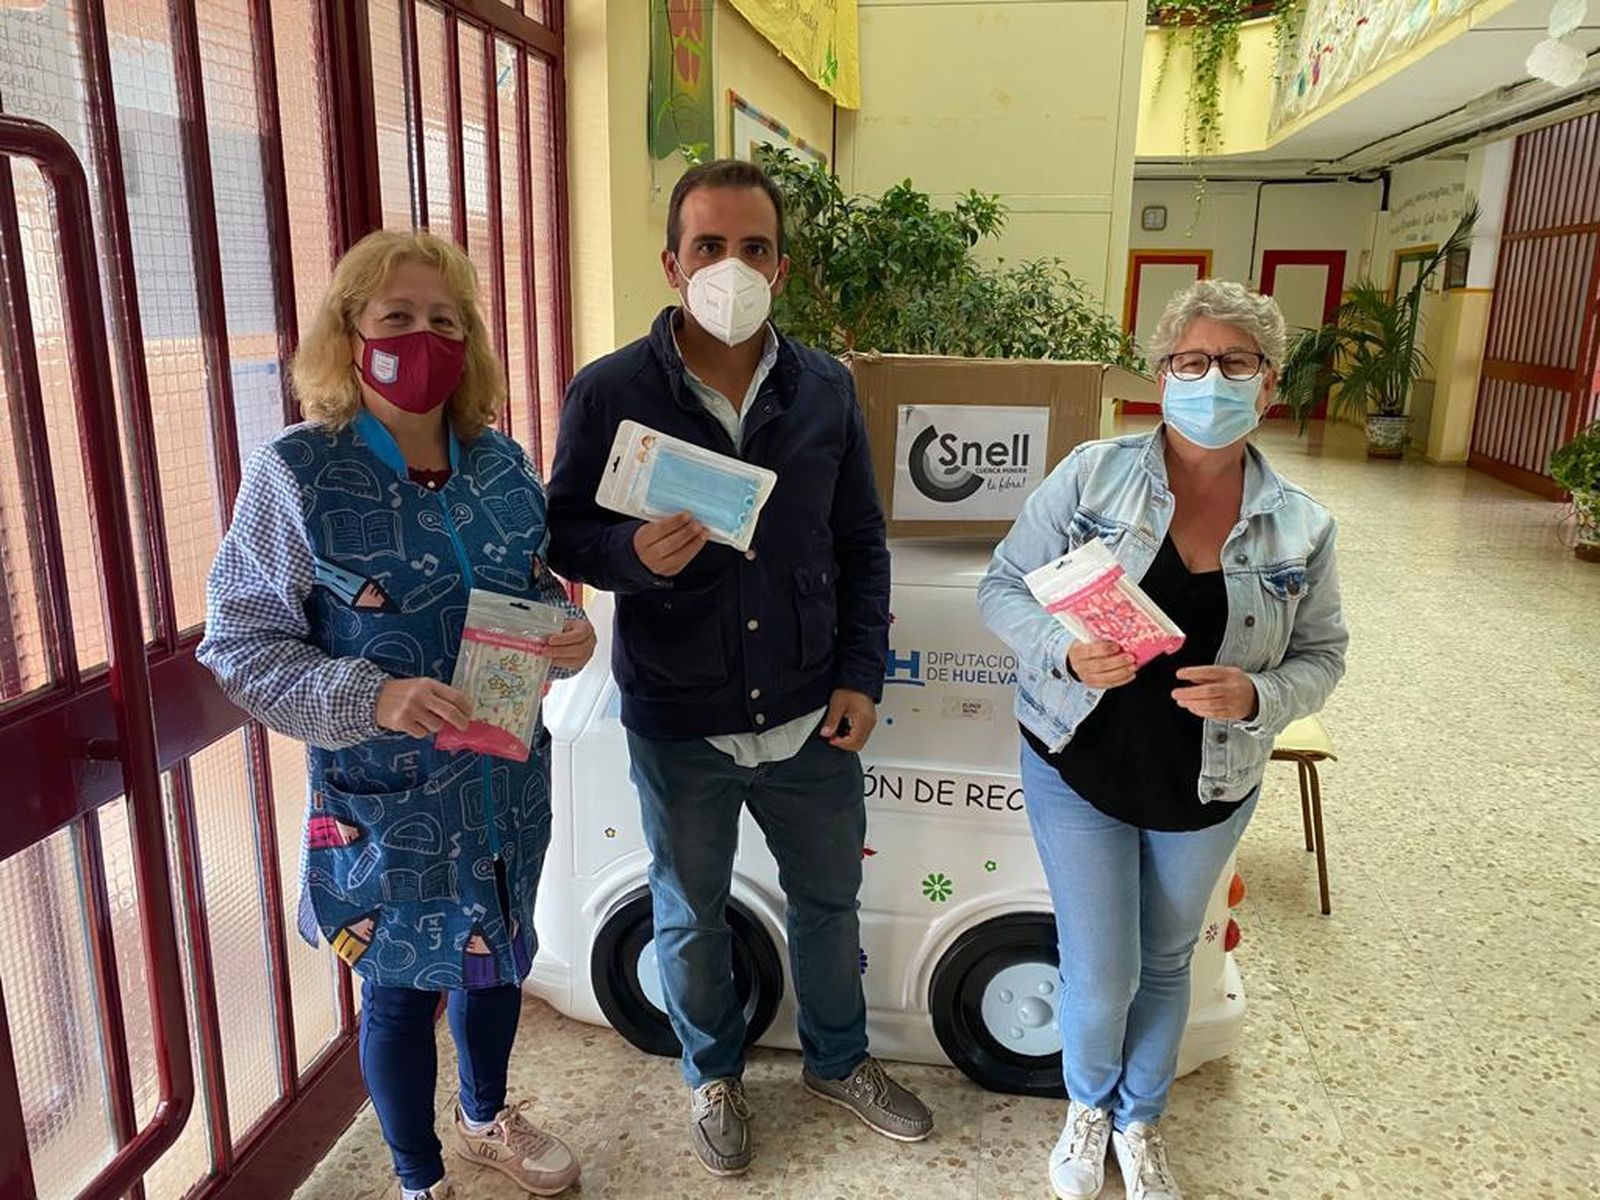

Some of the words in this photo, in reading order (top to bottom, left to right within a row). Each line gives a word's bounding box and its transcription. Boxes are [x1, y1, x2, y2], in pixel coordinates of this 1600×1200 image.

[938, 433, 1030, 467] Snell
[926, 667, 949, 682] DE
[952, 669, 1019, 685] HUELVA
[914, 778, 956, 806] DE
